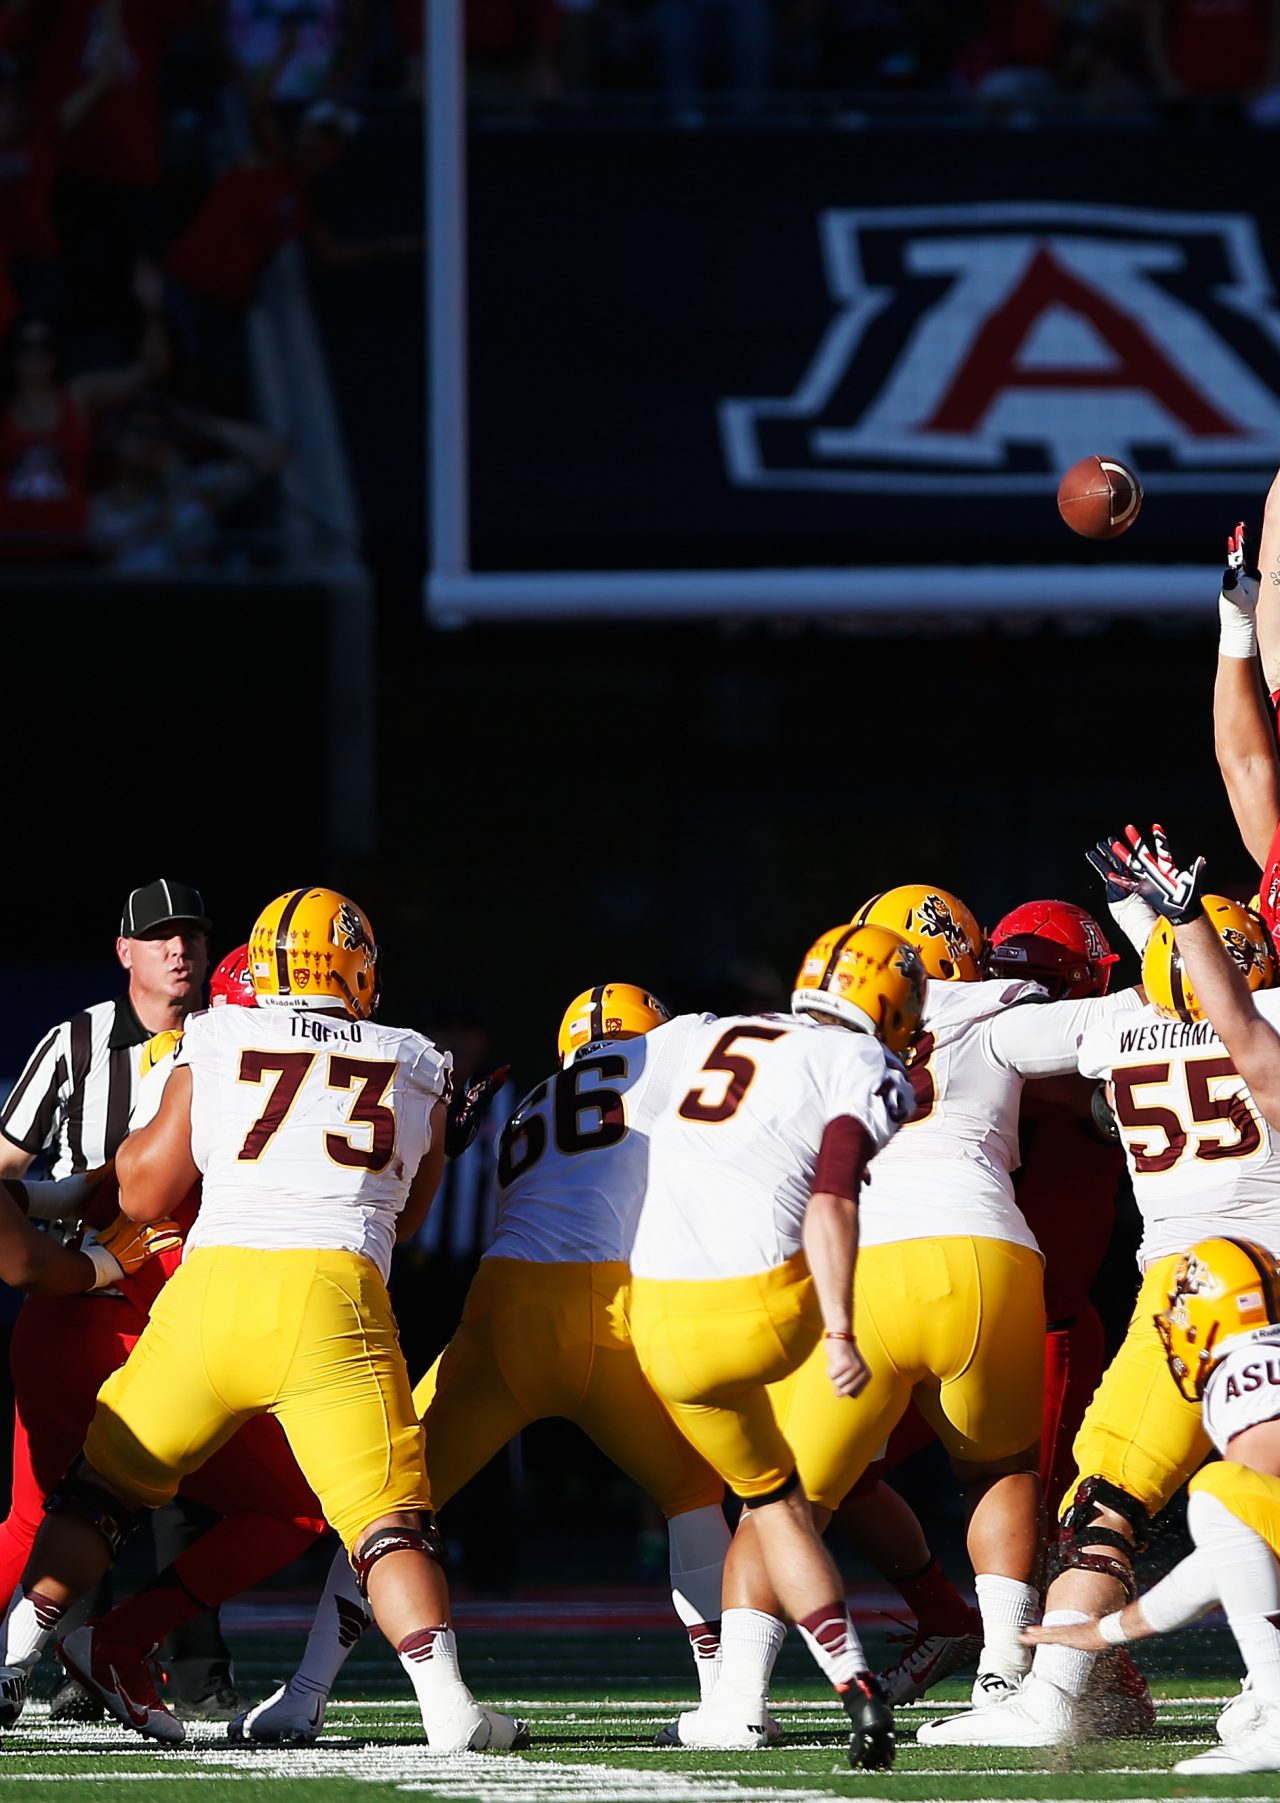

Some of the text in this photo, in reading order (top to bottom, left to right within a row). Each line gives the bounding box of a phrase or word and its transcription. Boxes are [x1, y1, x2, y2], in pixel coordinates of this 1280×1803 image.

[269, 998, 302, 1007] Riddell
[289, 1017, 362, 1042] TEOFILO
[1119, 1020, 1223, 1054] WESTERMA
[675, 1024, 792, 1126] 5
[235, 1048, 401, 1174] 73
[497, 1055, 628, 1188] 66
[1111, 1053, 1266, 1176] 55
[976, 1672, 1009, 1694] KE
